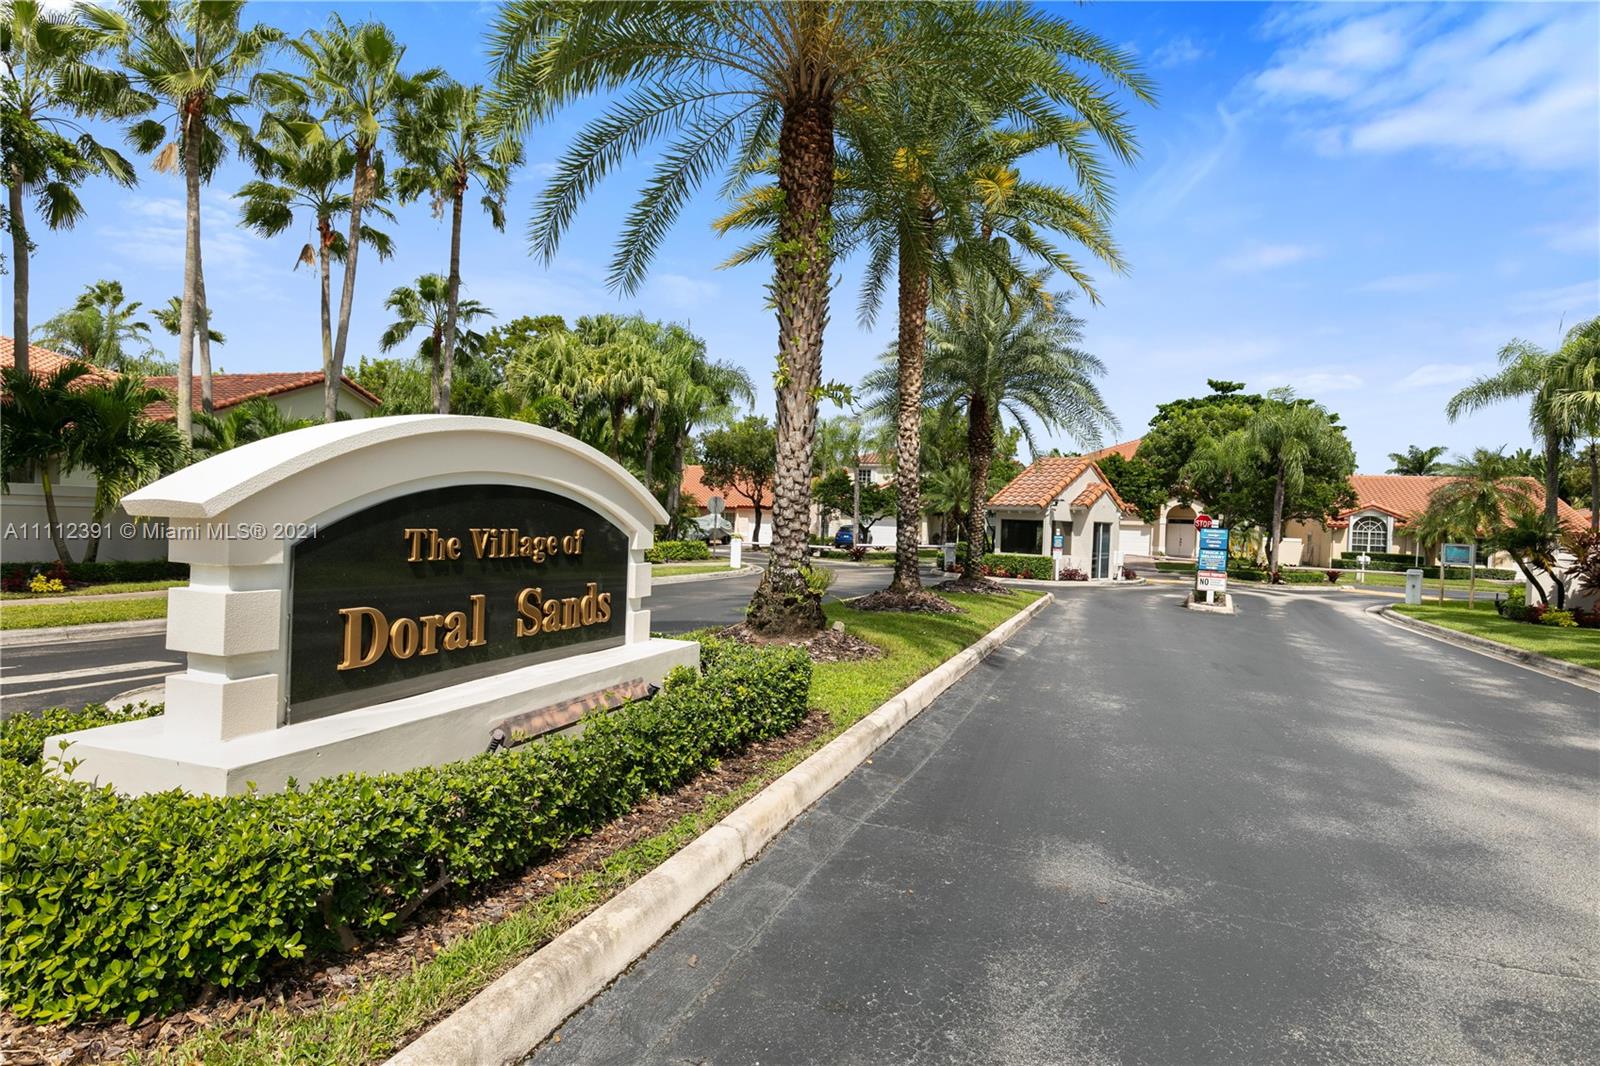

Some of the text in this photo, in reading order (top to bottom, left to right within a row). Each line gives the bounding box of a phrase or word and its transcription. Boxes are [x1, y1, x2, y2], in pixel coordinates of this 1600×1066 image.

[404, 528, 585, 564] The Village of
[337, 582, 611, 671] Doral Sands
